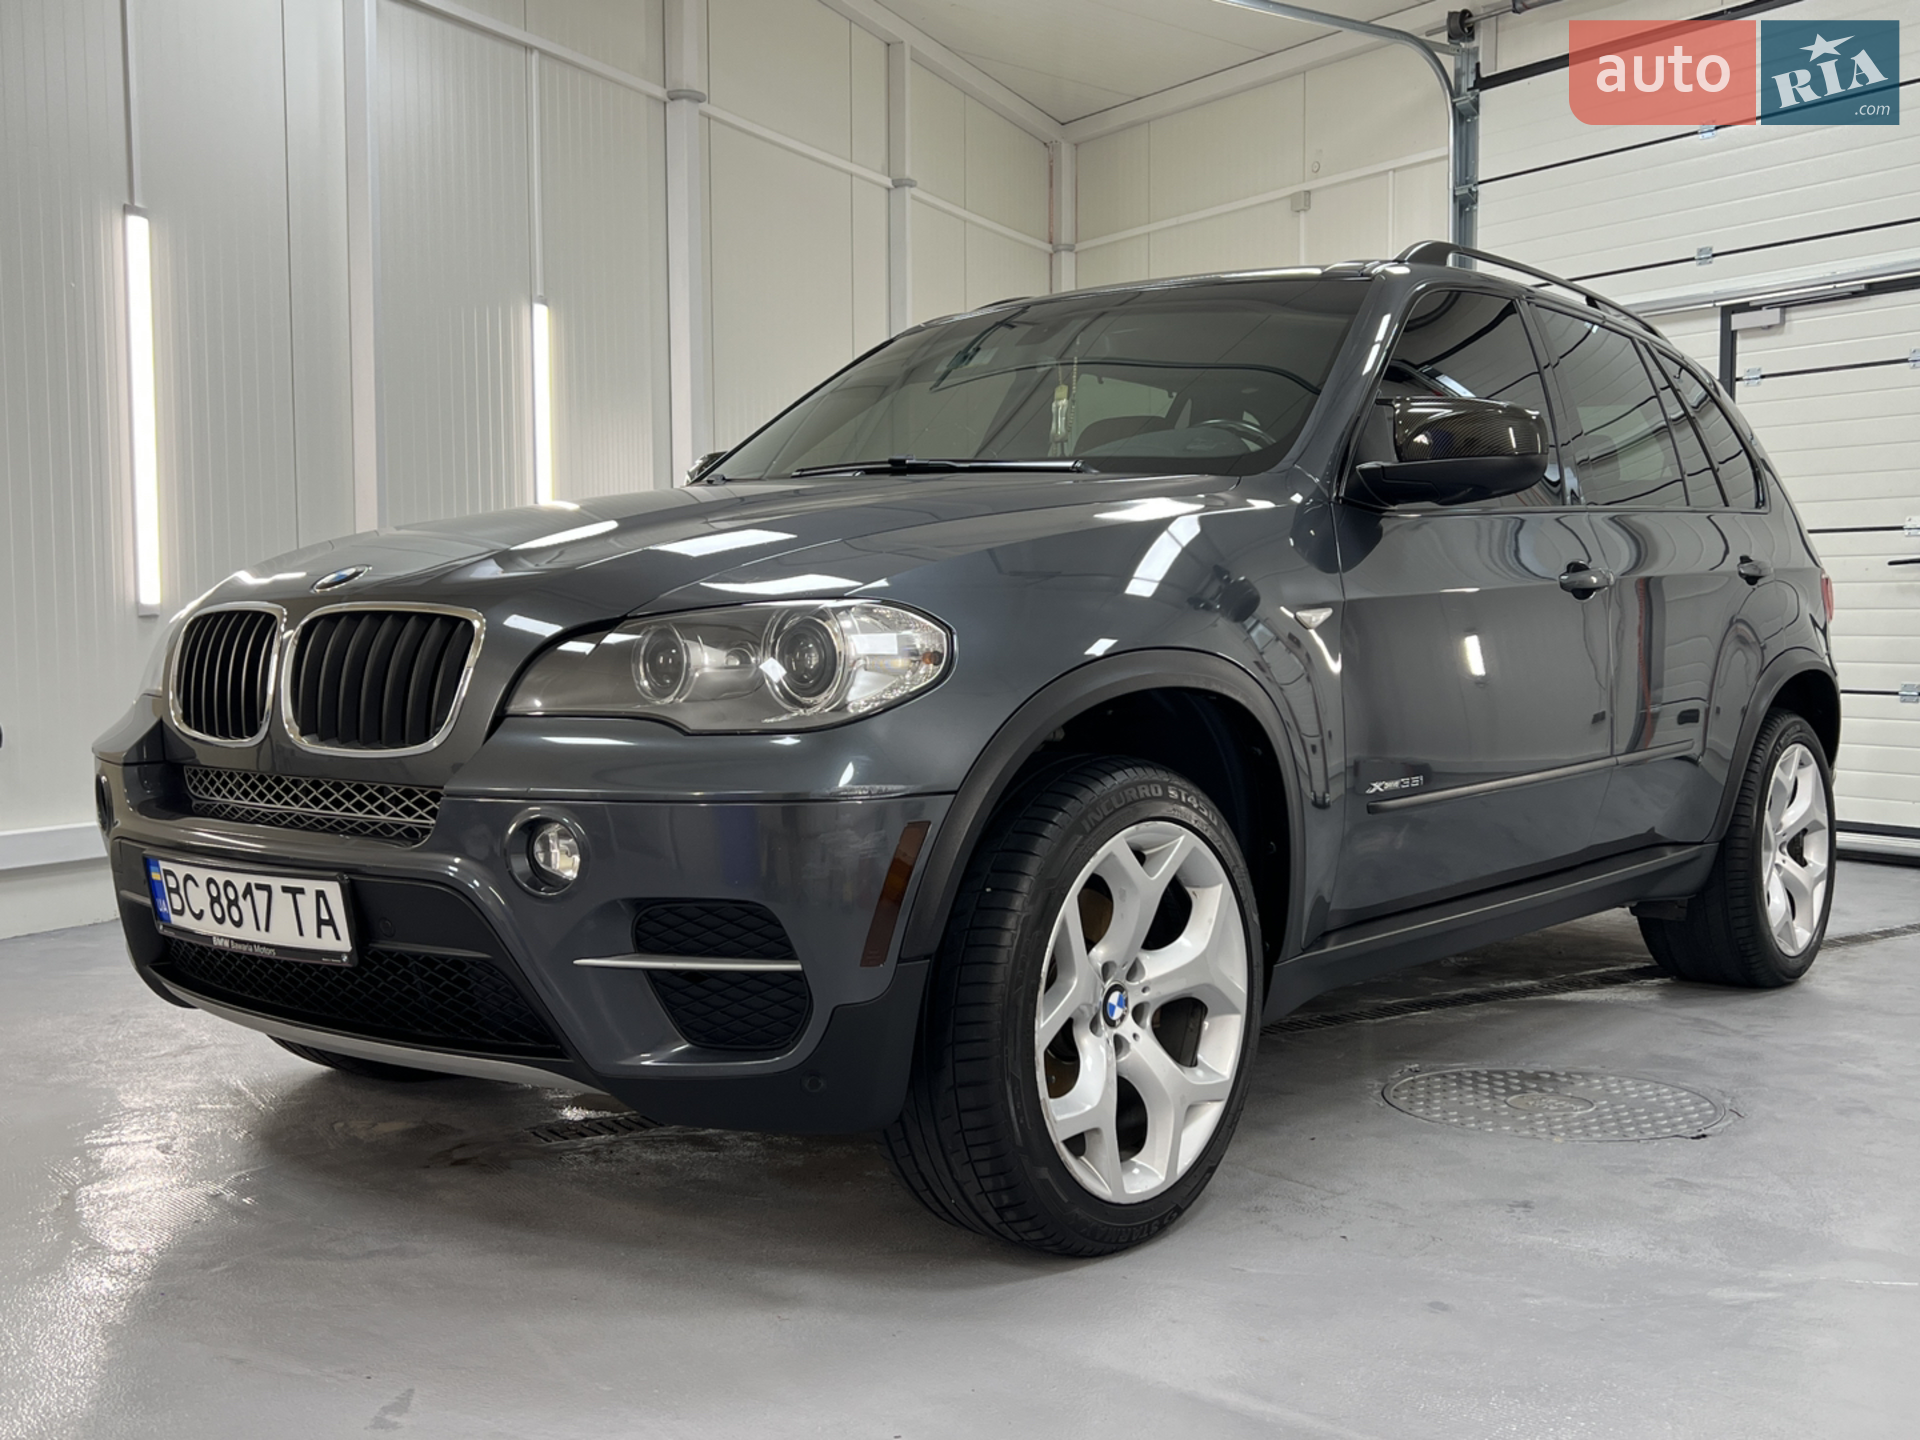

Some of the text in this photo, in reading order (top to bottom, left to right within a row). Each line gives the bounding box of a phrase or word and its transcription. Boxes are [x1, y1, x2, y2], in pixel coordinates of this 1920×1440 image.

[1081, 784, 1163, 833] INCURRO
[155, 898, 168, 913] UA
[162, 868, 341, 941] BC 8817 TA
[212, 936, 230, 948] BMW
[253, 944, 276, 957] Motors
